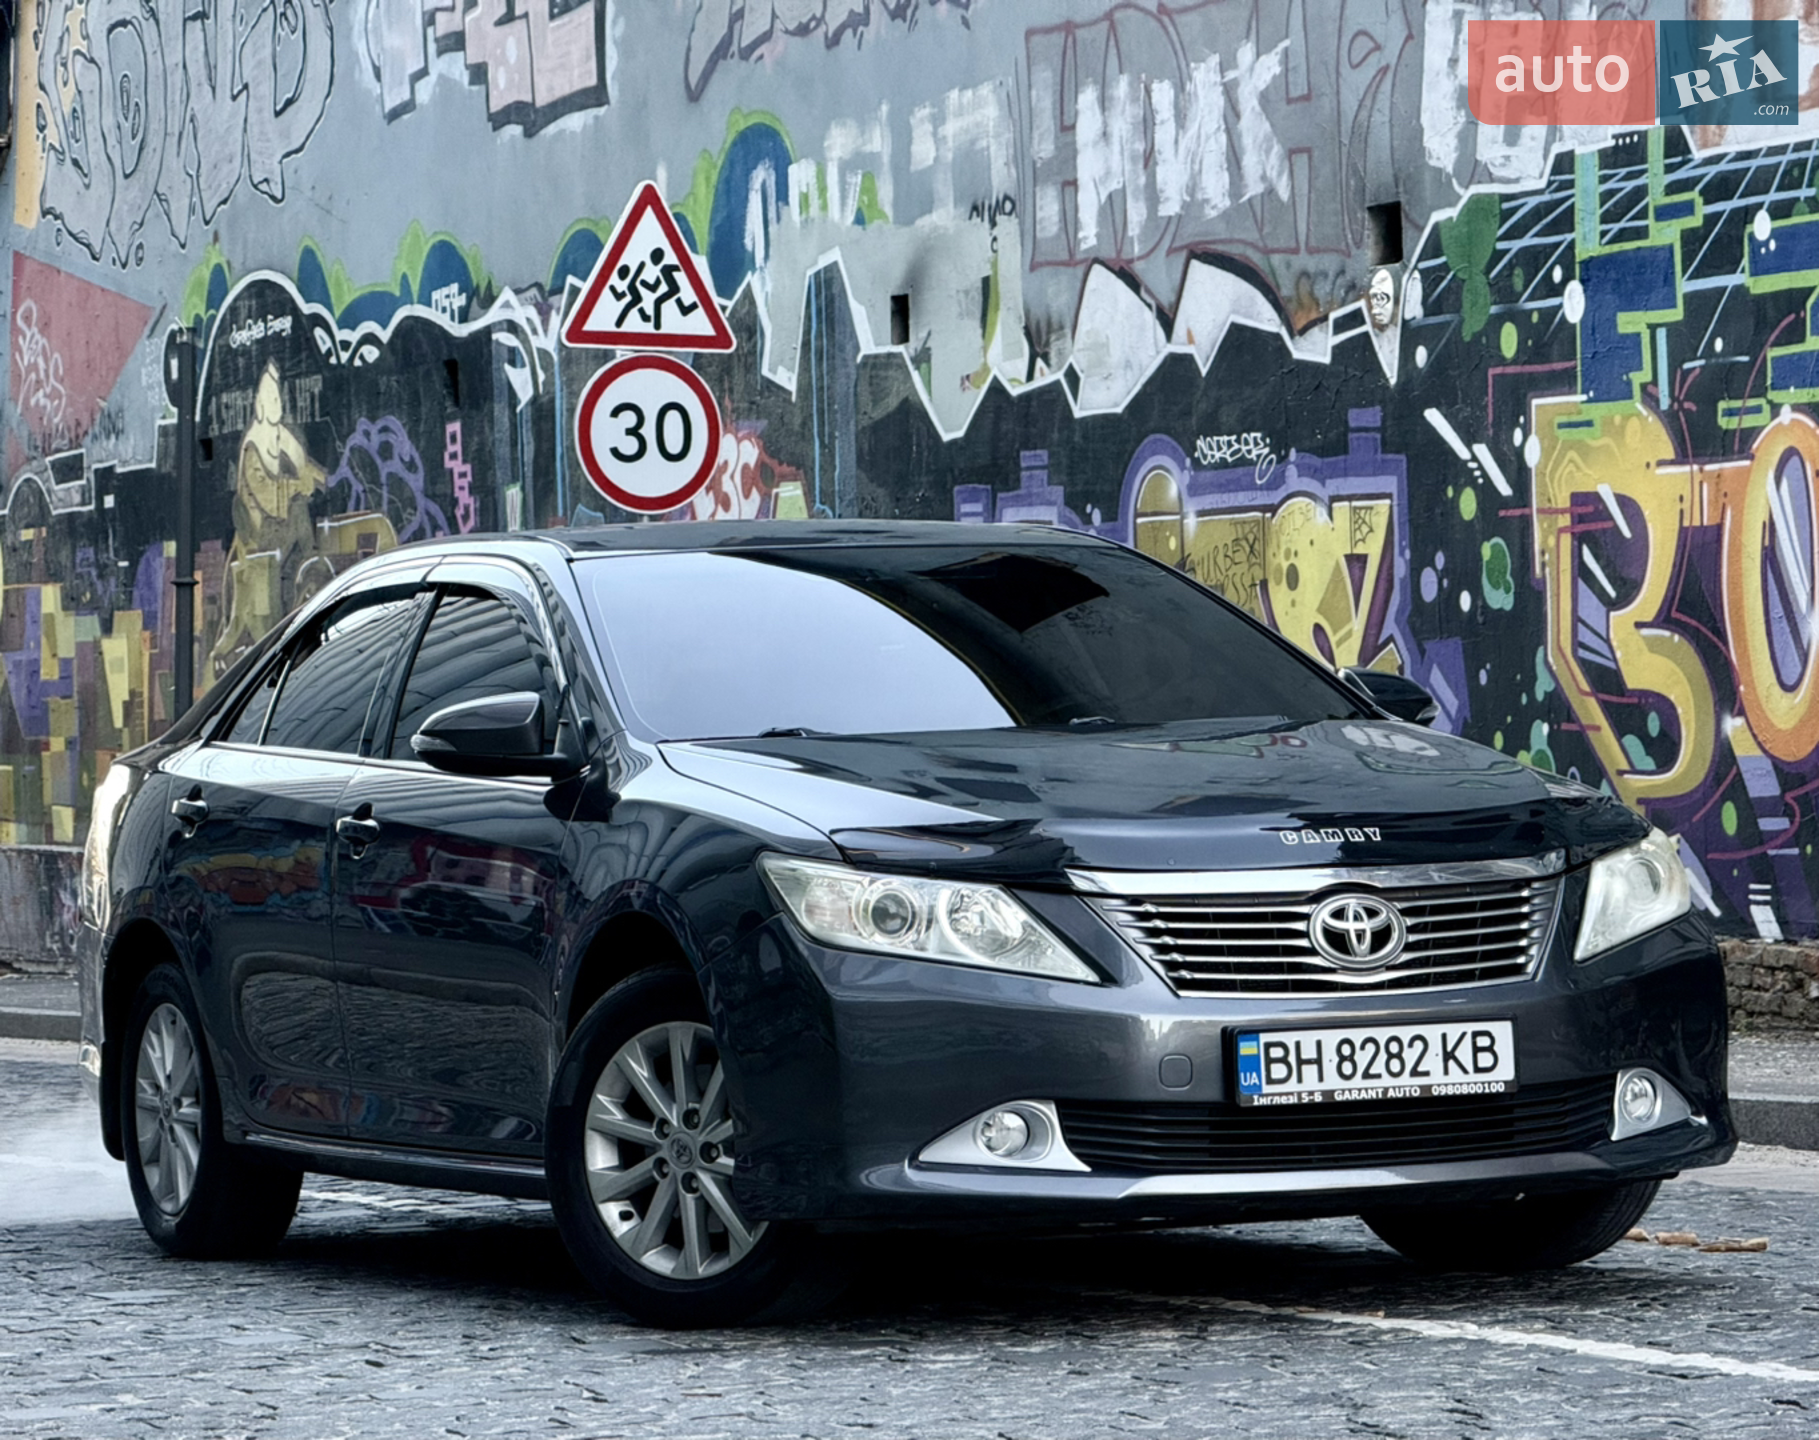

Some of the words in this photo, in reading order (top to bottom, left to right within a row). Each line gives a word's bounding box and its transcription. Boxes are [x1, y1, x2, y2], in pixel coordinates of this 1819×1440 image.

[609, 401, 692, 463] 30
[1280, 827, 1381, 845] CAMRY
[1263, 1039, 1324, 1085] BH
[1335, 1034, 1430, 1081] 8282
[1441, 1030, 1498, 1076] KB
[1240, 1071, 1260, 1086] UA
[1334, 1087, 1383, 1101] GARANT
[1387, 1086, 1420, 1098] AUTO
[1431, 1081, 1505, 1096] 0980800100
